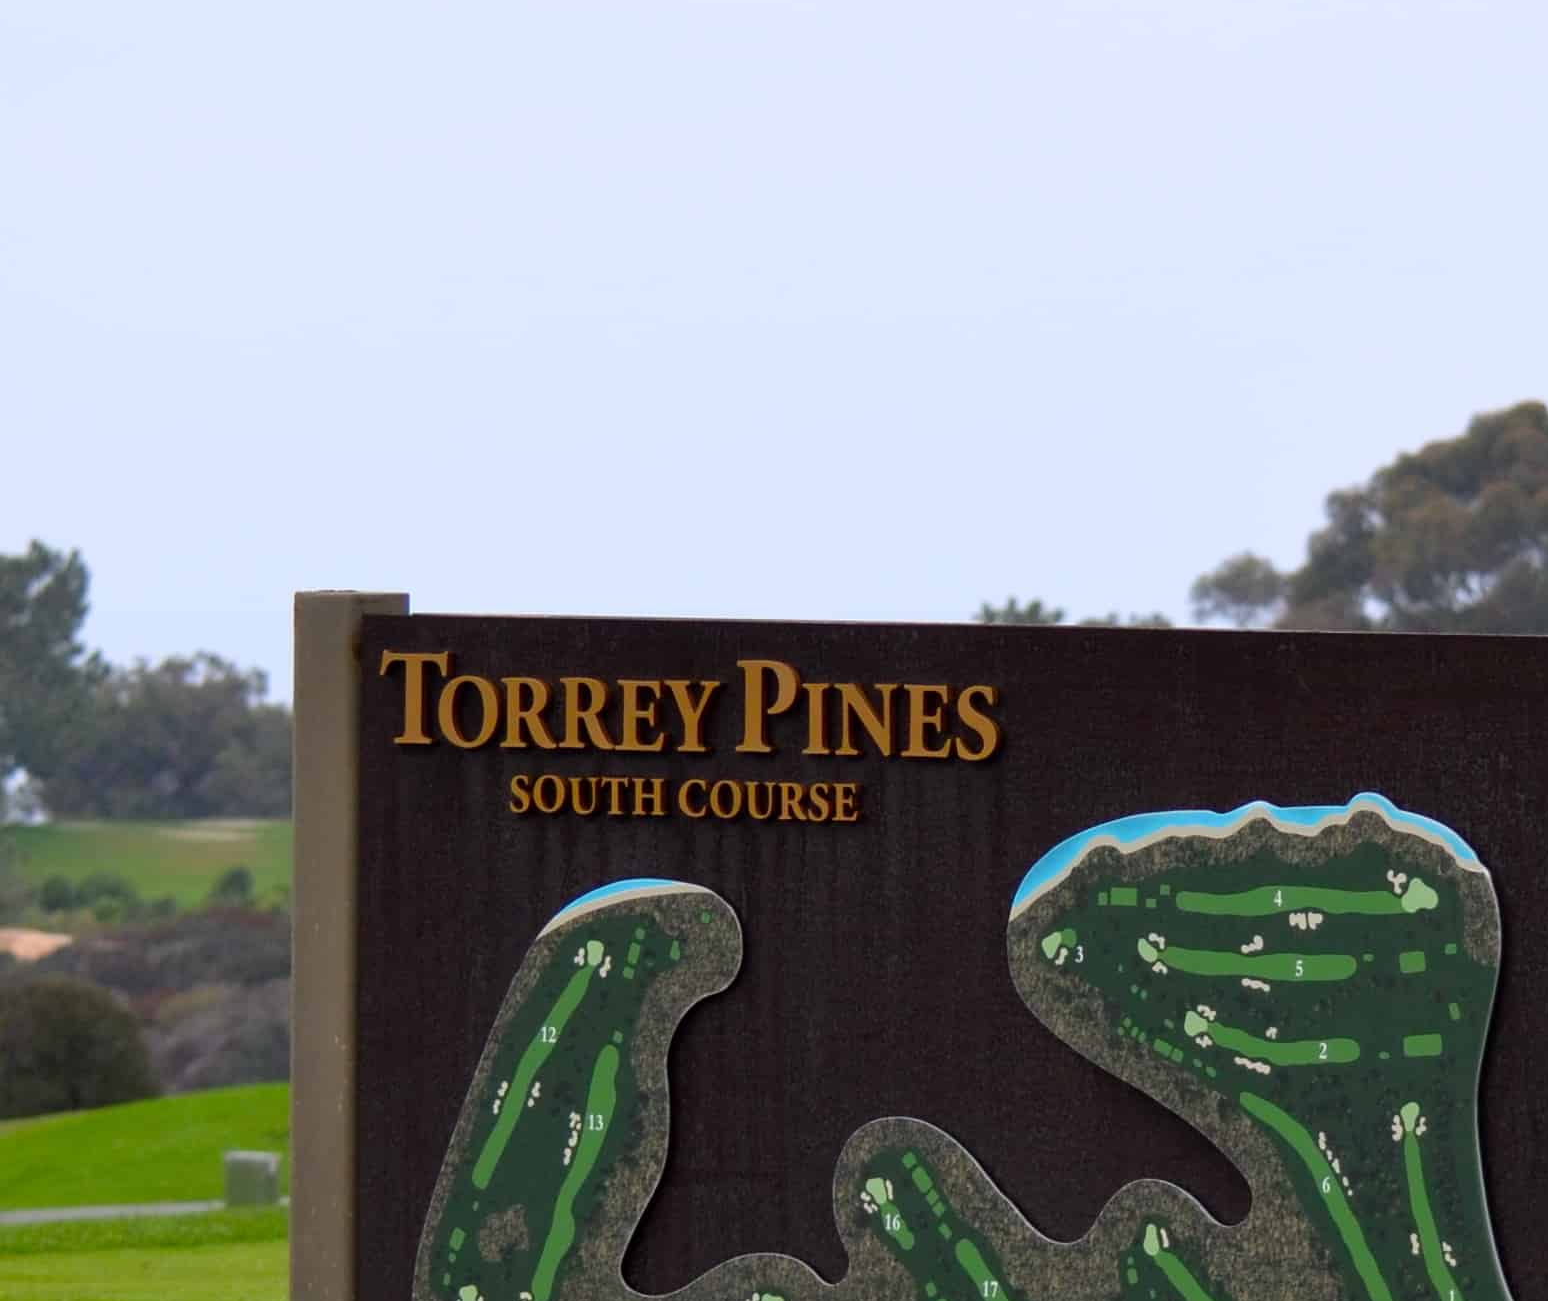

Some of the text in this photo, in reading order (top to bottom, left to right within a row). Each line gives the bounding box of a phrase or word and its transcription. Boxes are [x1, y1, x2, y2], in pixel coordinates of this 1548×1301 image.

[508, 774, 860, 823] SOUTH COURSE
[1273, 889, 1283, 907] 4
[1074, 946, 1084, 963] 3
[1295, 959, 1305, 977] 5
[540, 1027, 557, 1043] 12
[1318, 1043, 1328, 1060] 2
[588, 1114, 604, 1131] 13
[1321, 1176, 1331, 1193] 6
[884, 1213, 901, 1231] 16
[982, 1280, 998, 1298] 17
